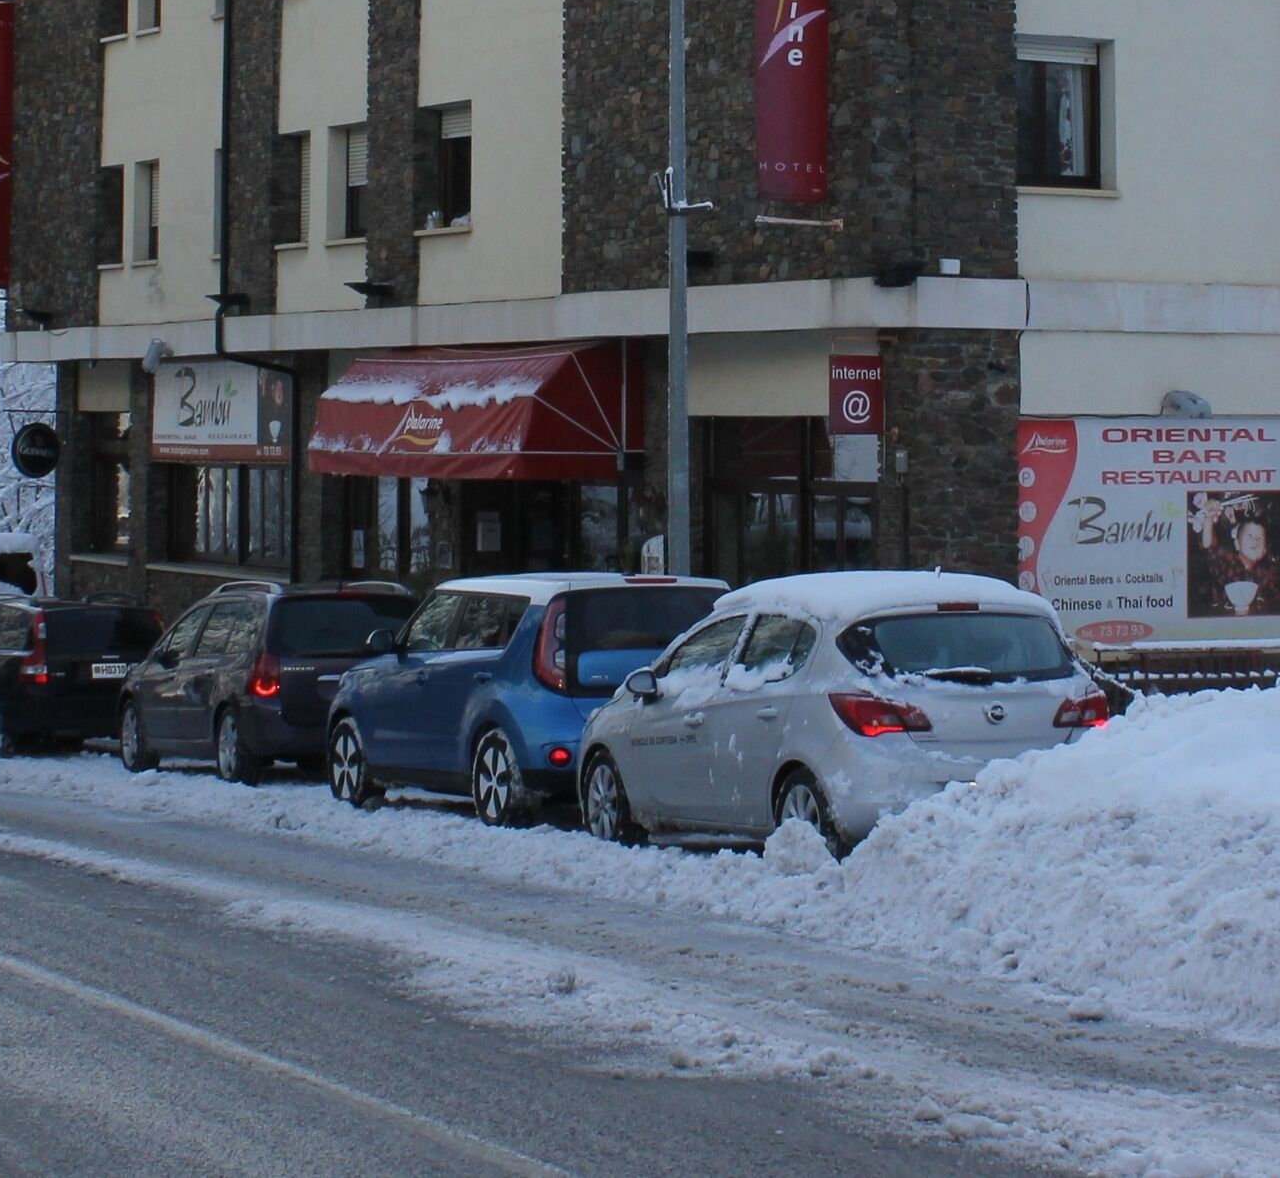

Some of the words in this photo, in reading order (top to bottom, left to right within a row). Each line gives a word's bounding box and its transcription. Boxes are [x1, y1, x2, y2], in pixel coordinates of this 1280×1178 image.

[759, 162, 824, 173] HOTEL
[831, 366, 881, 380] internet
[175, 366, 231, 427] Bambu
[842, 390, 871, 424] @
[1101, 427, 1276, 443] ORIENTAL
[1152, 449, 1227, 464] BAR
[1101, 469, 1276, 485] RESTAURANT
[1067, 496, 1173, 545] Bambu
[1054, 574, 1088, 586] Oriental
[1090, 574, 1114, 585] Beers
[1125, 573, 1164, 584] Cocktails
[1051, 598, 1102, 611] Chinese
[1106, 599, 1113, 609] &
[1116, 596, 1143, 609] Thai
[1146, 595, 1174, 608] food
[1099, 625, 1113, 637] 73
[1115, 625, 1129, 637] 73
[1130, 624, 1145, 636] 93
